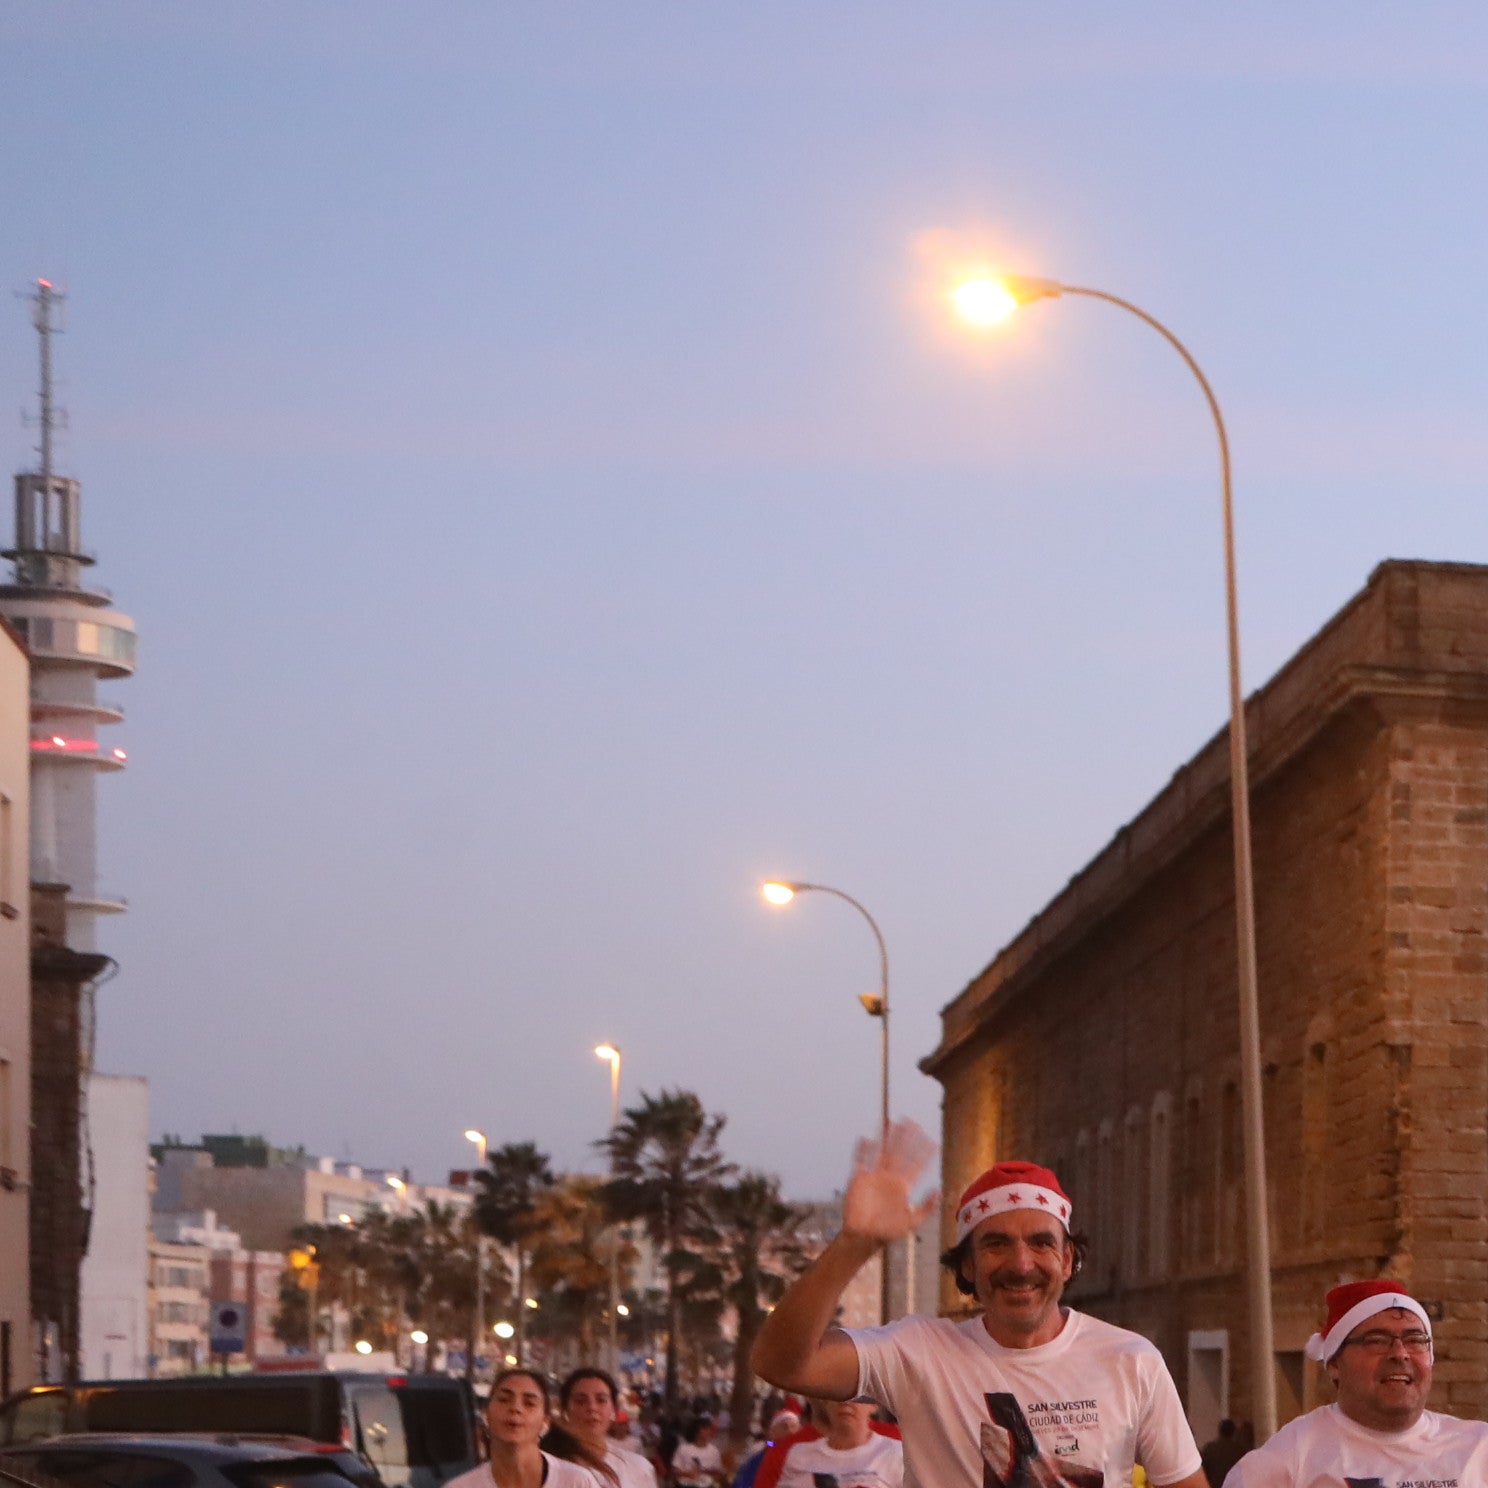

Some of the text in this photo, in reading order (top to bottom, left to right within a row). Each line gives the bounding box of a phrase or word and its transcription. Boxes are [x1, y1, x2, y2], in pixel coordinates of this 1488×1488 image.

[1028, 1400, 1097, 1413] SAN SILVESTRE
[1029, 1416, 1061, 1427] CIUDAD
[1064, 1414, 1073, 1424] DE
[1415, 1479, 1458, 1488] SILVESTRE
